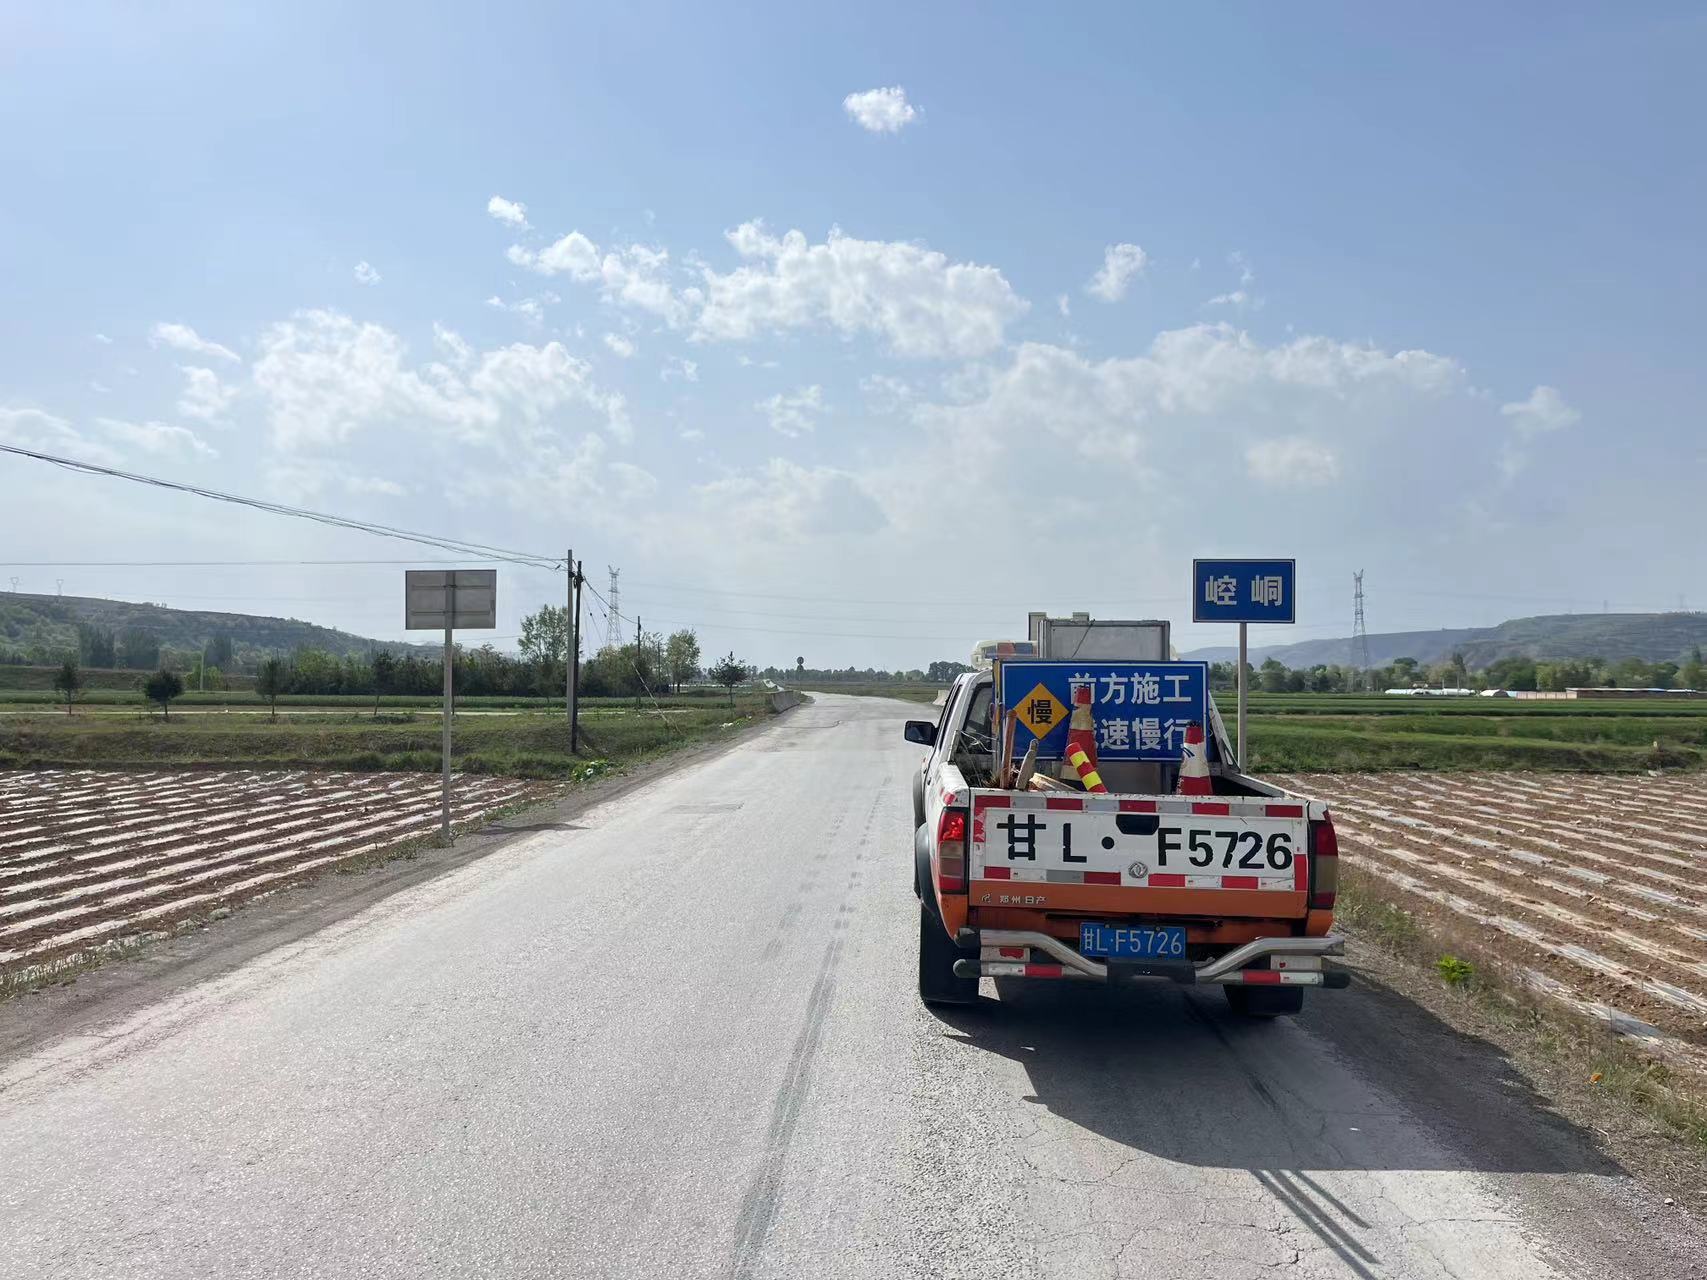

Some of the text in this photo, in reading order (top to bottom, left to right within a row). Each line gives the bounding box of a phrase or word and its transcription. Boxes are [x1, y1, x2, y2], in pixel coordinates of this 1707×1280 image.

[1205, 575, 1283, 606] 崆峒
[1068, 672, 1192, 704] 前方施工
[1028, 699, 1053, 725] 慢
[1093, 717, 1191, 750] 速慢行
